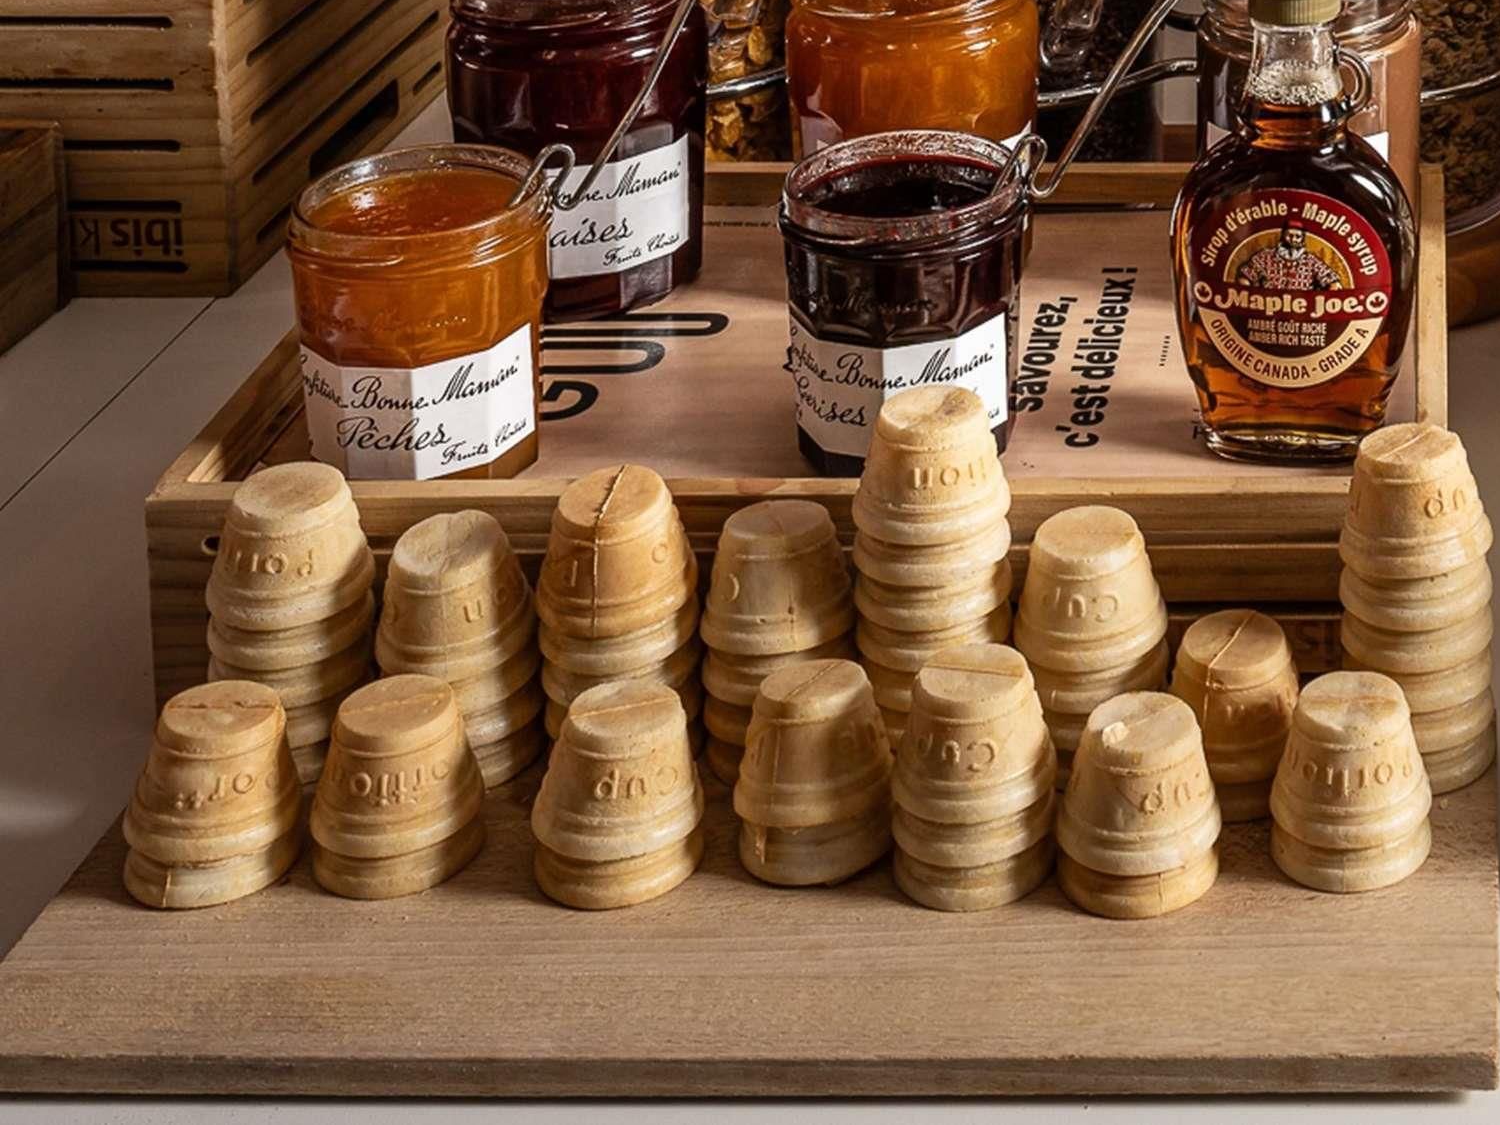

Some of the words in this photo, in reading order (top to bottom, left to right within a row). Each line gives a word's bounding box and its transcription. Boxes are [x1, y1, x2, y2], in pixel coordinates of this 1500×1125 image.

[1200, 227, 1229, 267] Sirop
[1225, 198, 1288, 232] d'érable
[1302, 202, 1351, 236] Maple
[1347, 232, 1378, 275] syrup
[1214, 287, 1308, 315] Maple
[1309, 295, 1365, 318] Joe
[1070, 278, 1137, 380] délicieux
[1211, 318, 1254, 367] ORIGINE
[1253, 358, 1310, 380] CANADA
[1318, 337, 1361, 373] GRADE
[1356, 327, 1369, 339] A
[1300, 334, 1326, 346] TASTE
[351, 375, 430, 411] Bonne
[432, 362, 519, 406] Maman
[835, 352, 906, 390] Bonne
[910, 347, 994, 386] Maman
[336, 416, 452, 452] Pêches
[1055, 384, 1112, 448] c'est
